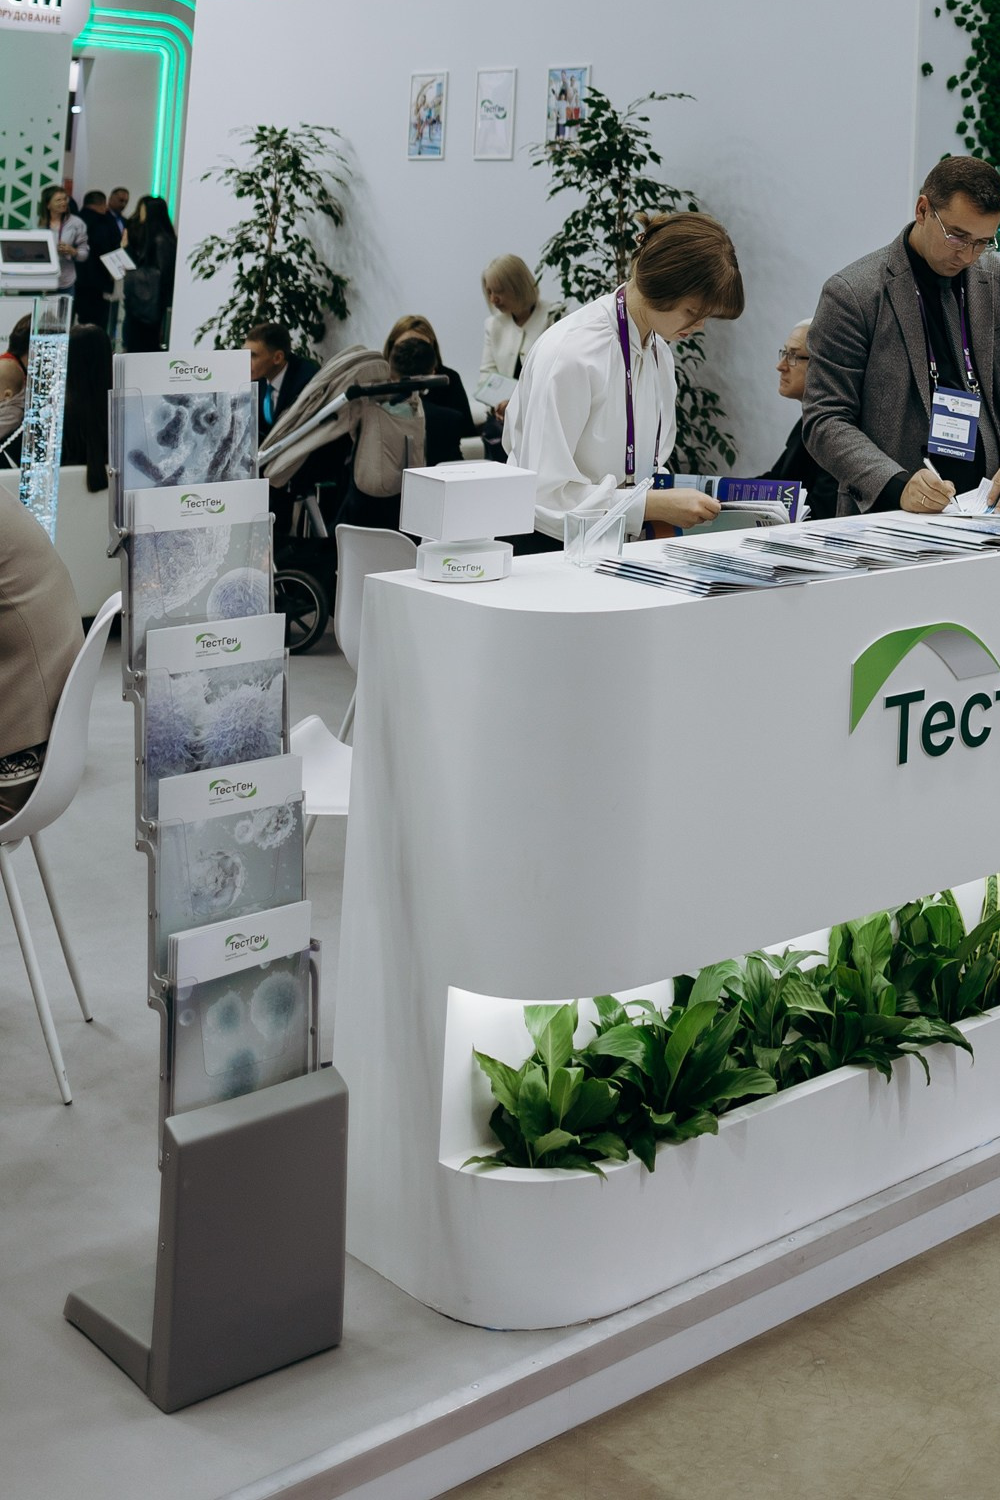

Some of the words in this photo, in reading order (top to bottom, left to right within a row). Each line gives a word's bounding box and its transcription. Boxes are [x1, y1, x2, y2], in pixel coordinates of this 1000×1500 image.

[174, 365, 209, 375] ТестГен
[185, 498, 222, 509] ТестГен
[446, 563, 482, 572] ТестГен
[200, 636, 238, 649] ТестГен
[214, 782, 253, 796] ТестГен
[230, 933, 266, 951] ТестГен
